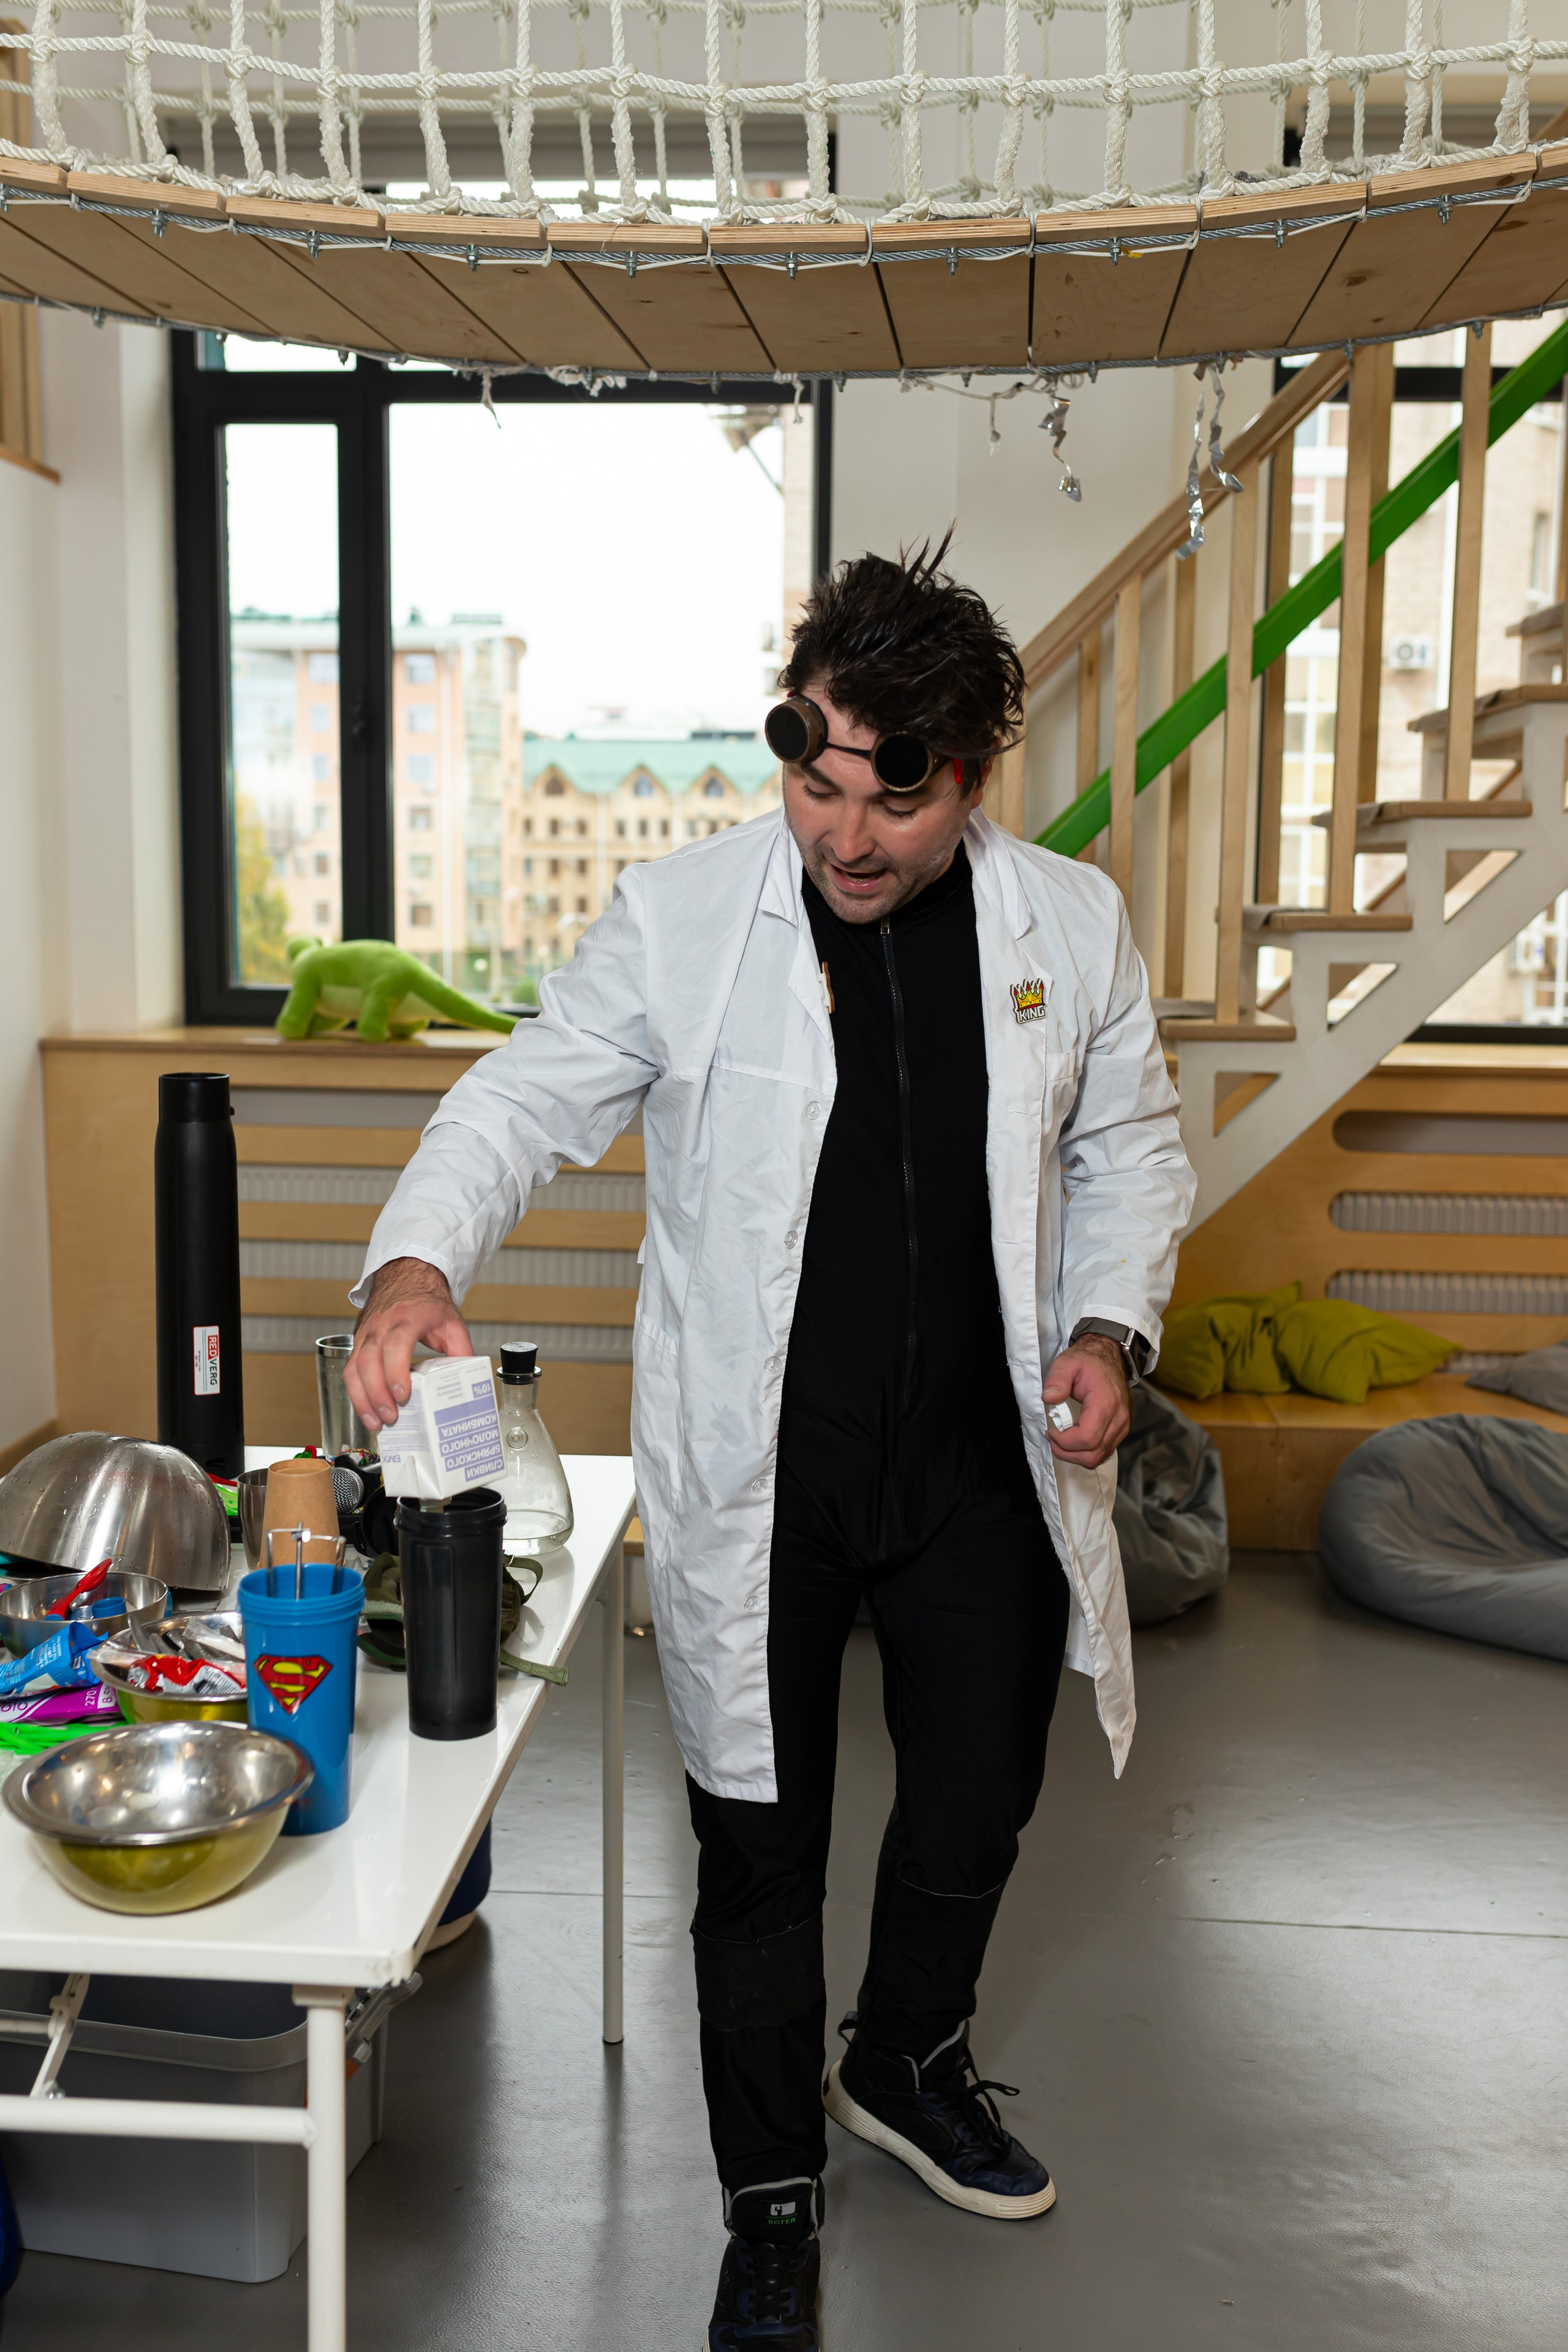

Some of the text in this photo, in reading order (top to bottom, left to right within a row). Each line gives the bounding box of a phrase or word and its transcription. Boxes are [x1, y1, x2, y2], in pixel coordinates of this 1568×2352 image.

[1019, 1005, 1045, 1022] KING
[473, 1383, 491, 1396] 10%
[441, 1413, 497, 1437] КОМБИНАТА
[442, 1428, 499, 1453] МОЛОЧНОГО
[447, 1444, 501, 1469] БРЯНСКОГО
[467, 1459, 503, 1479] СЛИВКИ
[85, 1691, 97, 1706] 270
